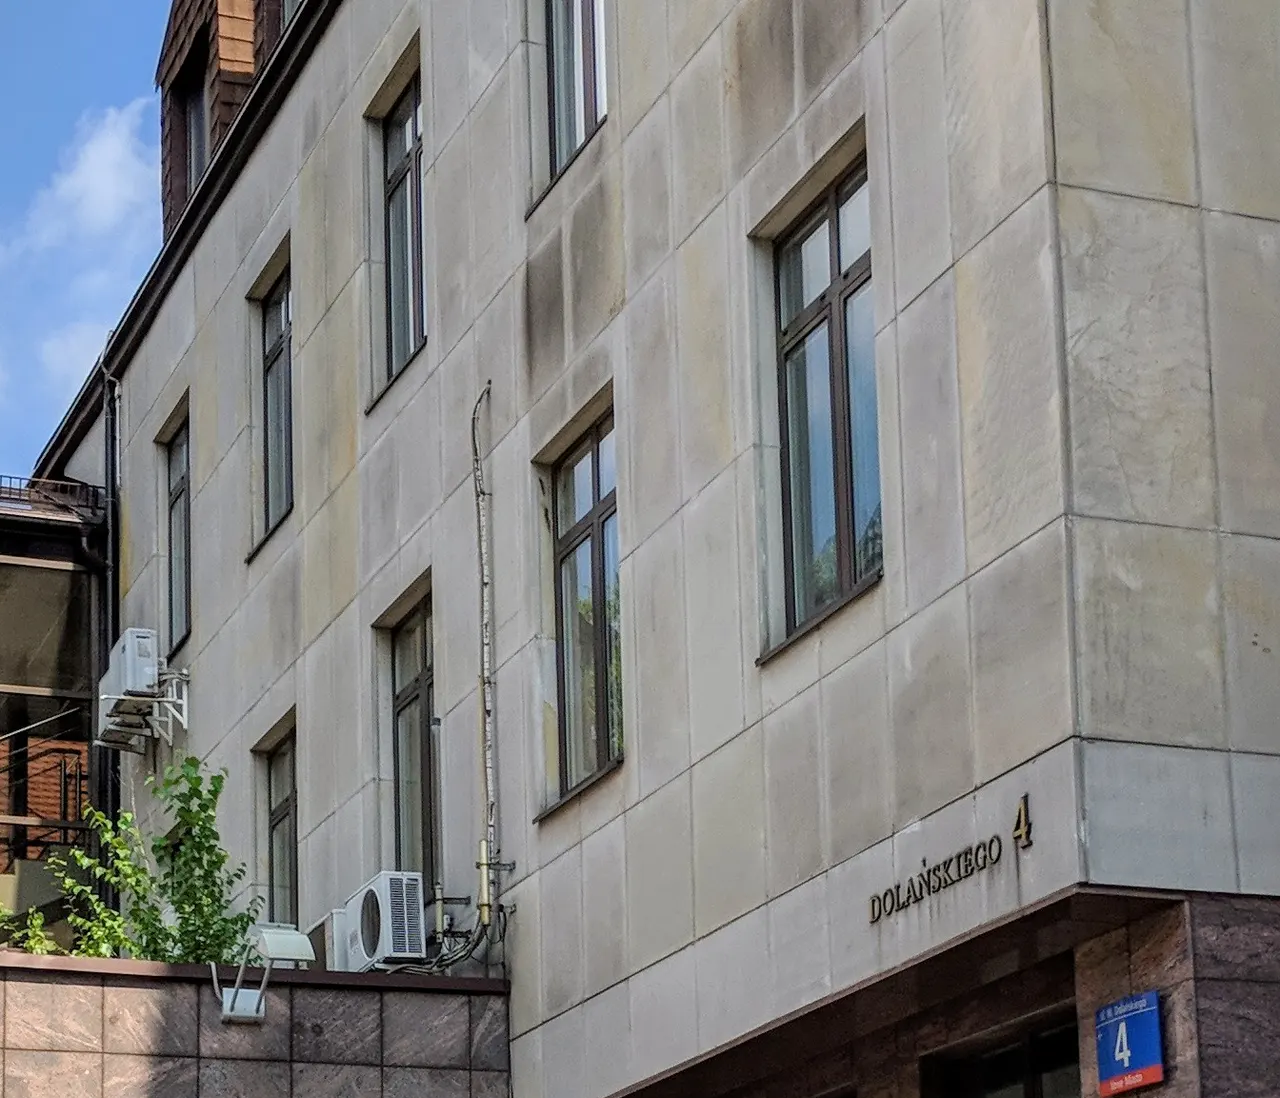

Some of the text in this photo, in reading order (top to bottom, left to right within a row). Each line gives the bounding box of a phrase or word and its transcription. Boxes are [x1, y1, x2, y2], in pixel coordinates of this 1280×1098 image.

[869, 792, 1033, 924] DOLAŃSKIEGO 4
[1115, 1021, 1131, 1067] 4
